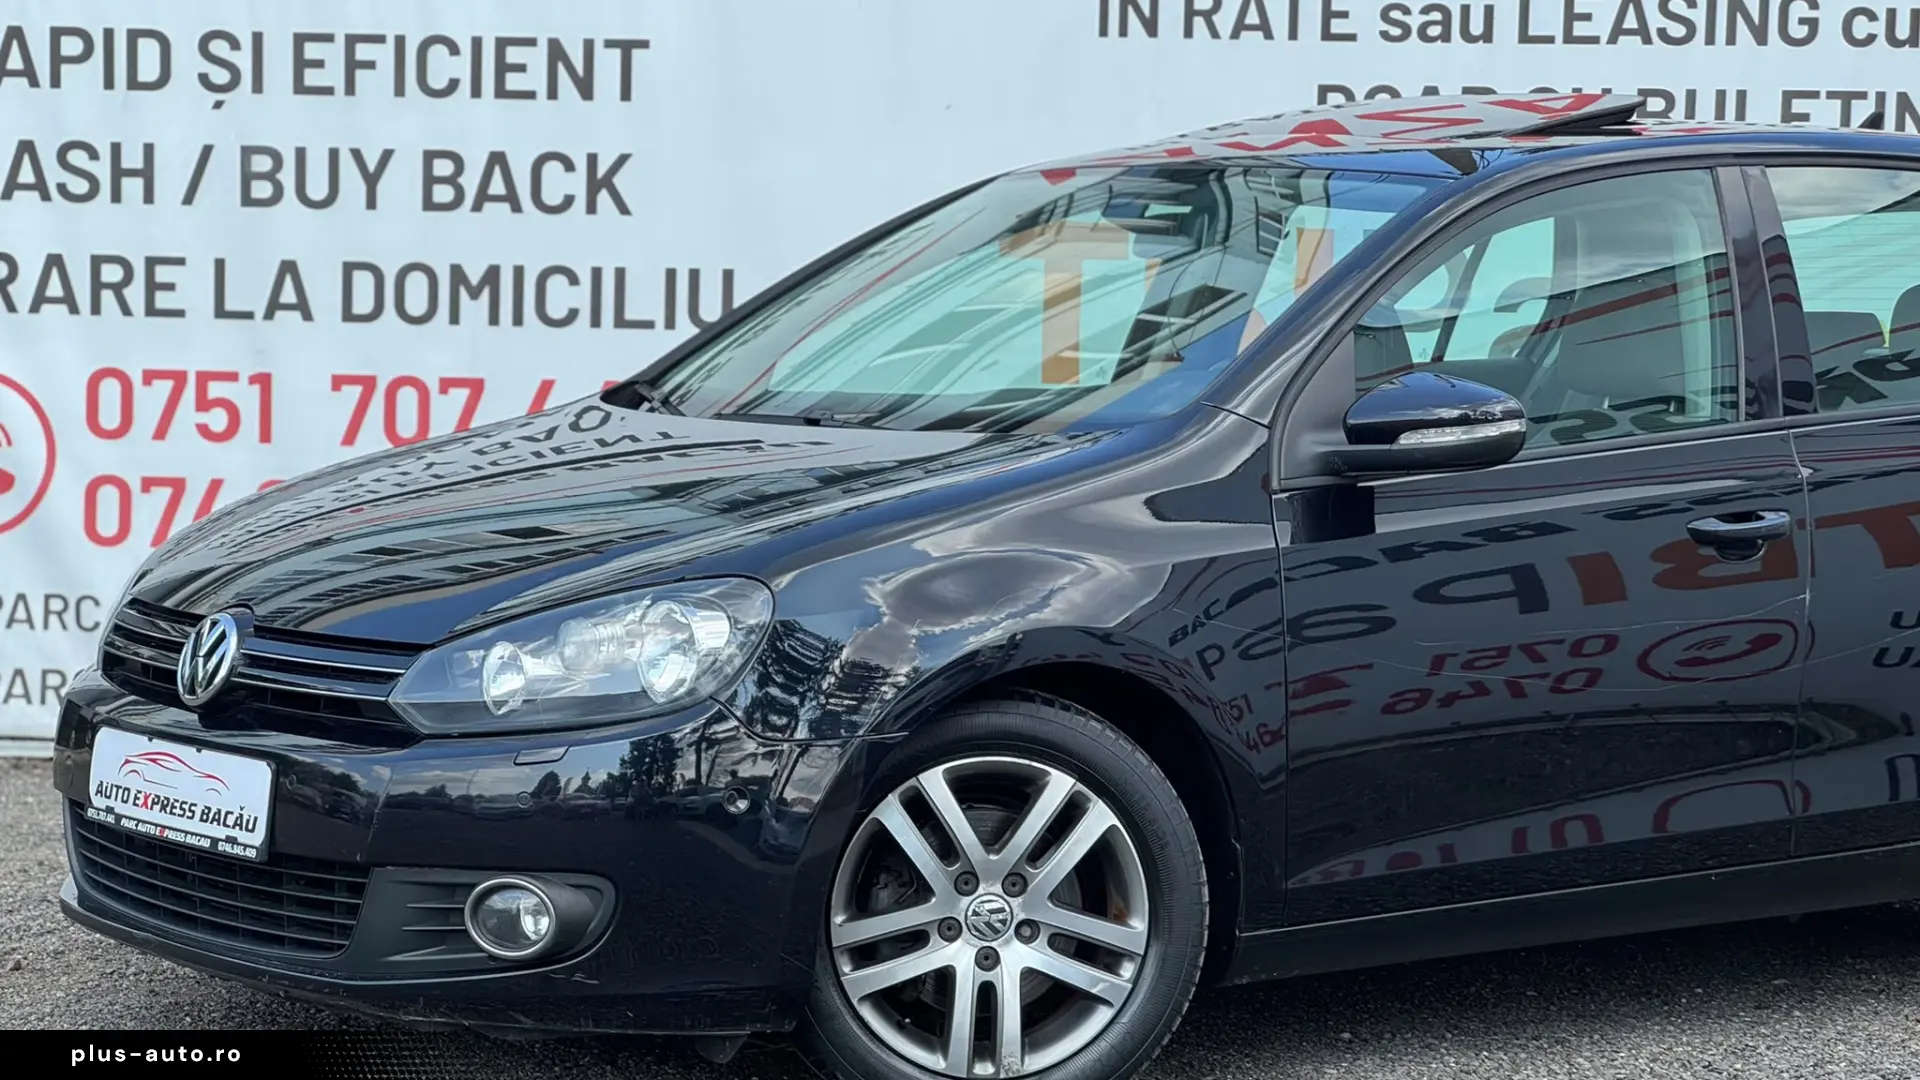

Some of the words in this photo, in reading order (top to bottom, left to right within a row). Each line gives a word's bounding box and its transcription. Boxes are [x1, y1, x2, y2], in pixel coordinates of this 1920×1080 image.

[1378, 2, 1494, 44] sau
[1517, 0, 1819, 48] LEASING
[1841, 7, 1920, 49] cu
[0, 25, 172, 92] APID
[198, 29, 264, 110] ȘI
[292, 32, 650, 102] EFICIENT
[0, 139, 155, 205] ASH
[181, 144, 214, 206] /
[240, 145, 395, 210] BUY
[421, 148, 633, 216] BACK
[213, 257, 313, 322] LA
[341, 261, 734, 330] DOMICILIU
[85, 366, 273, 444] 0751
[331, 374, 485, 447] 707
[0, 592, 102, 632] ARC
[95, 780, 131, 804] AUTO
[132, 789, 197, 820] EXPRESS
[199, 805, 259, 834] BACĂU
[120, 817, 138, 831] PARC
[138, 822, 156, 836] AUTO
[156, 826, 185, 843] EXPRESS
